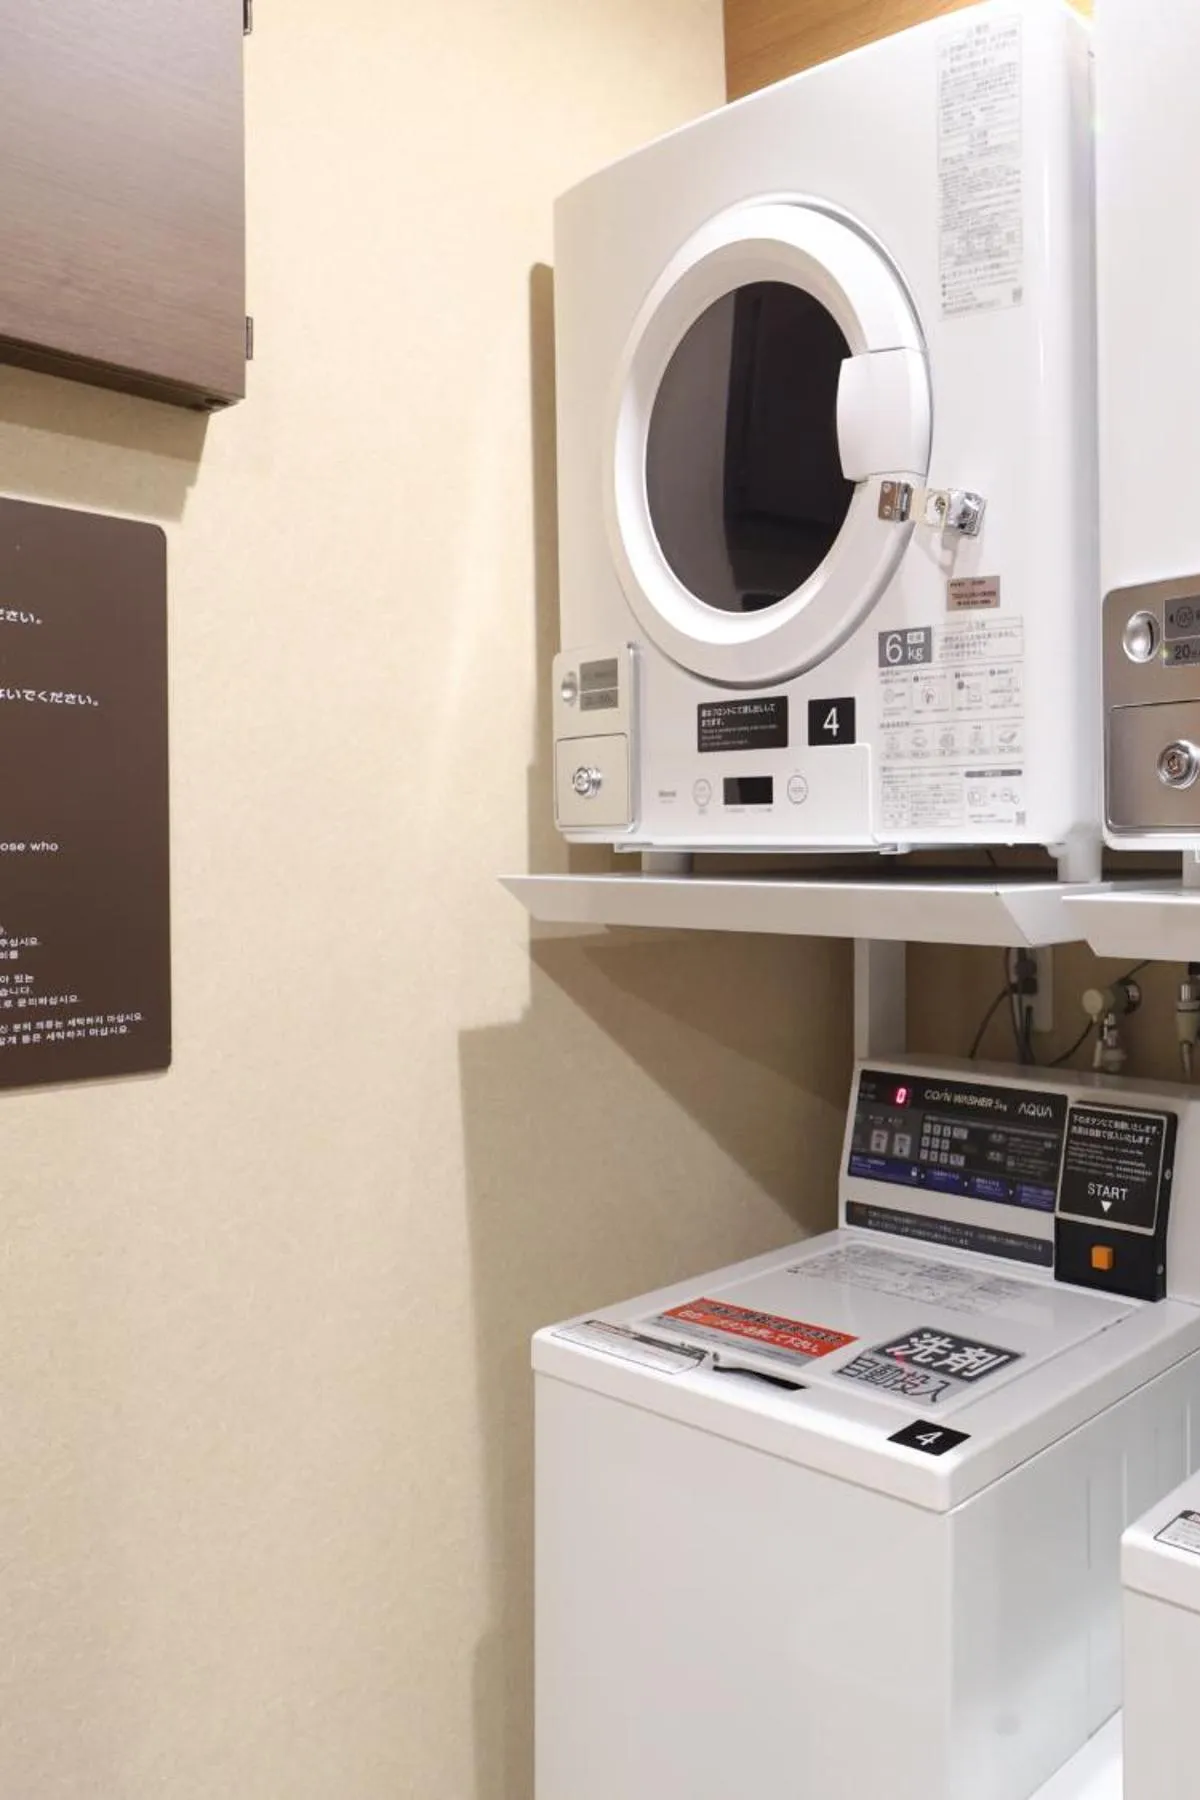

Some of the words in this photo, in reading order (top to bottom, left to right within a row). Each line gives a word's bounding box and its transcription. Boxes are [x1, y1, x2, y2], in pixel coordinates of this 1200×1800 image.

[886, 633, 902, 663] 6
[907, 646, 924, 661] kg
[823, 707, 840, 737] 4
[30, 840, 59, 852] who
[896, 1087, 907, 1104] 0
[1017, 1102, 1053, 1118] AQUA
[1088, 1182, 1128, 1200] START
[886, 1332, 1010, 1377] 洗剤
[835, 1354, 952, 1402] 自動投入
[914, 1431, 944, 1446] 4
